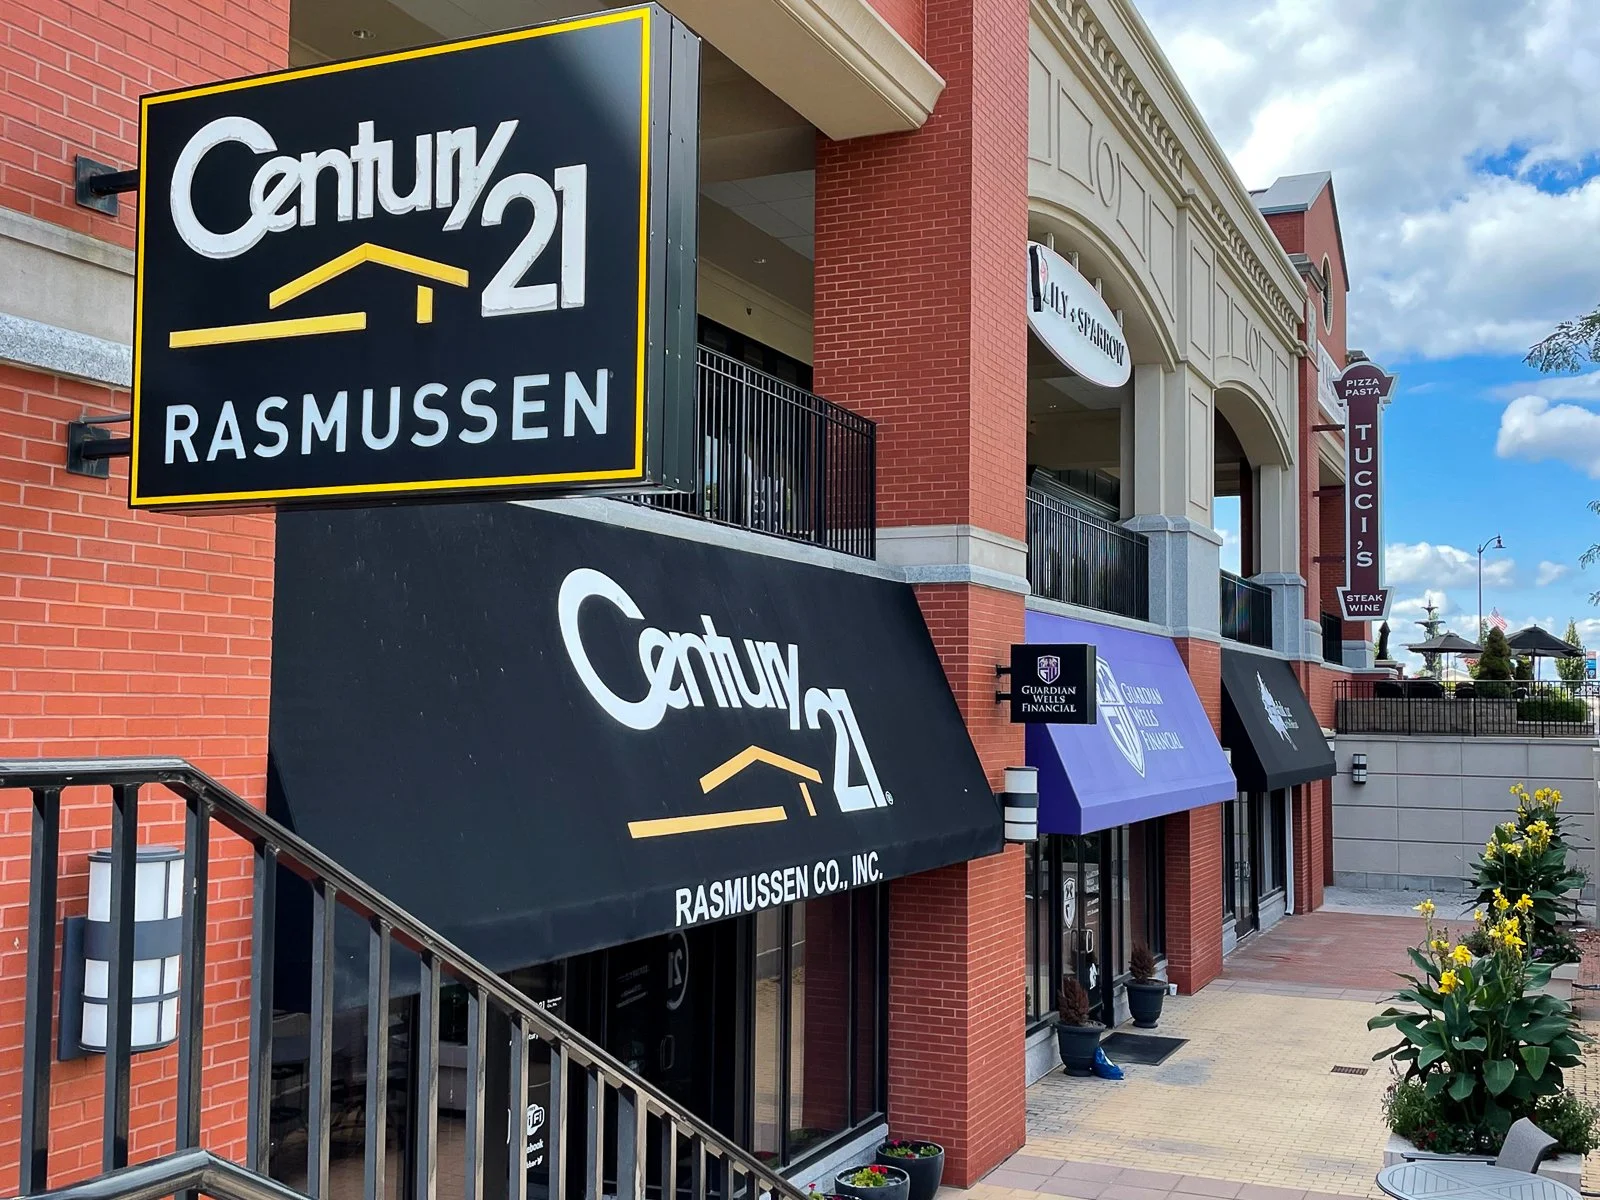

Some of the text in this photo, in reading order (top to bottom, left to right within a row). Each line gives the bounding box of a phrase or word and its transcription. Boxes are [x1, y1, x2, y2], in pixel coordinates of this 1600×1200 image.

[170, 115, 519, 261] Century
[480, 163, 588, 319] 21
[1077, 307, 1126, 367] SPARROW
[163, 367, 609, 465] RASMUSSEN
[1345, 387, 1381, 397] PASTA
[1346, 378, 1380, 387] PIZZA
[1354, 424, 1373, 567] TUCCI'S
[1346, 594, 1383, 602] STEAK
[1349, 602, 1381, 612] WINE
[558, 567, 801, 731] Century
[804, 687, 888, 813] 21
[675, 850, 884, 927] RASMUSSEN CO., INC.
